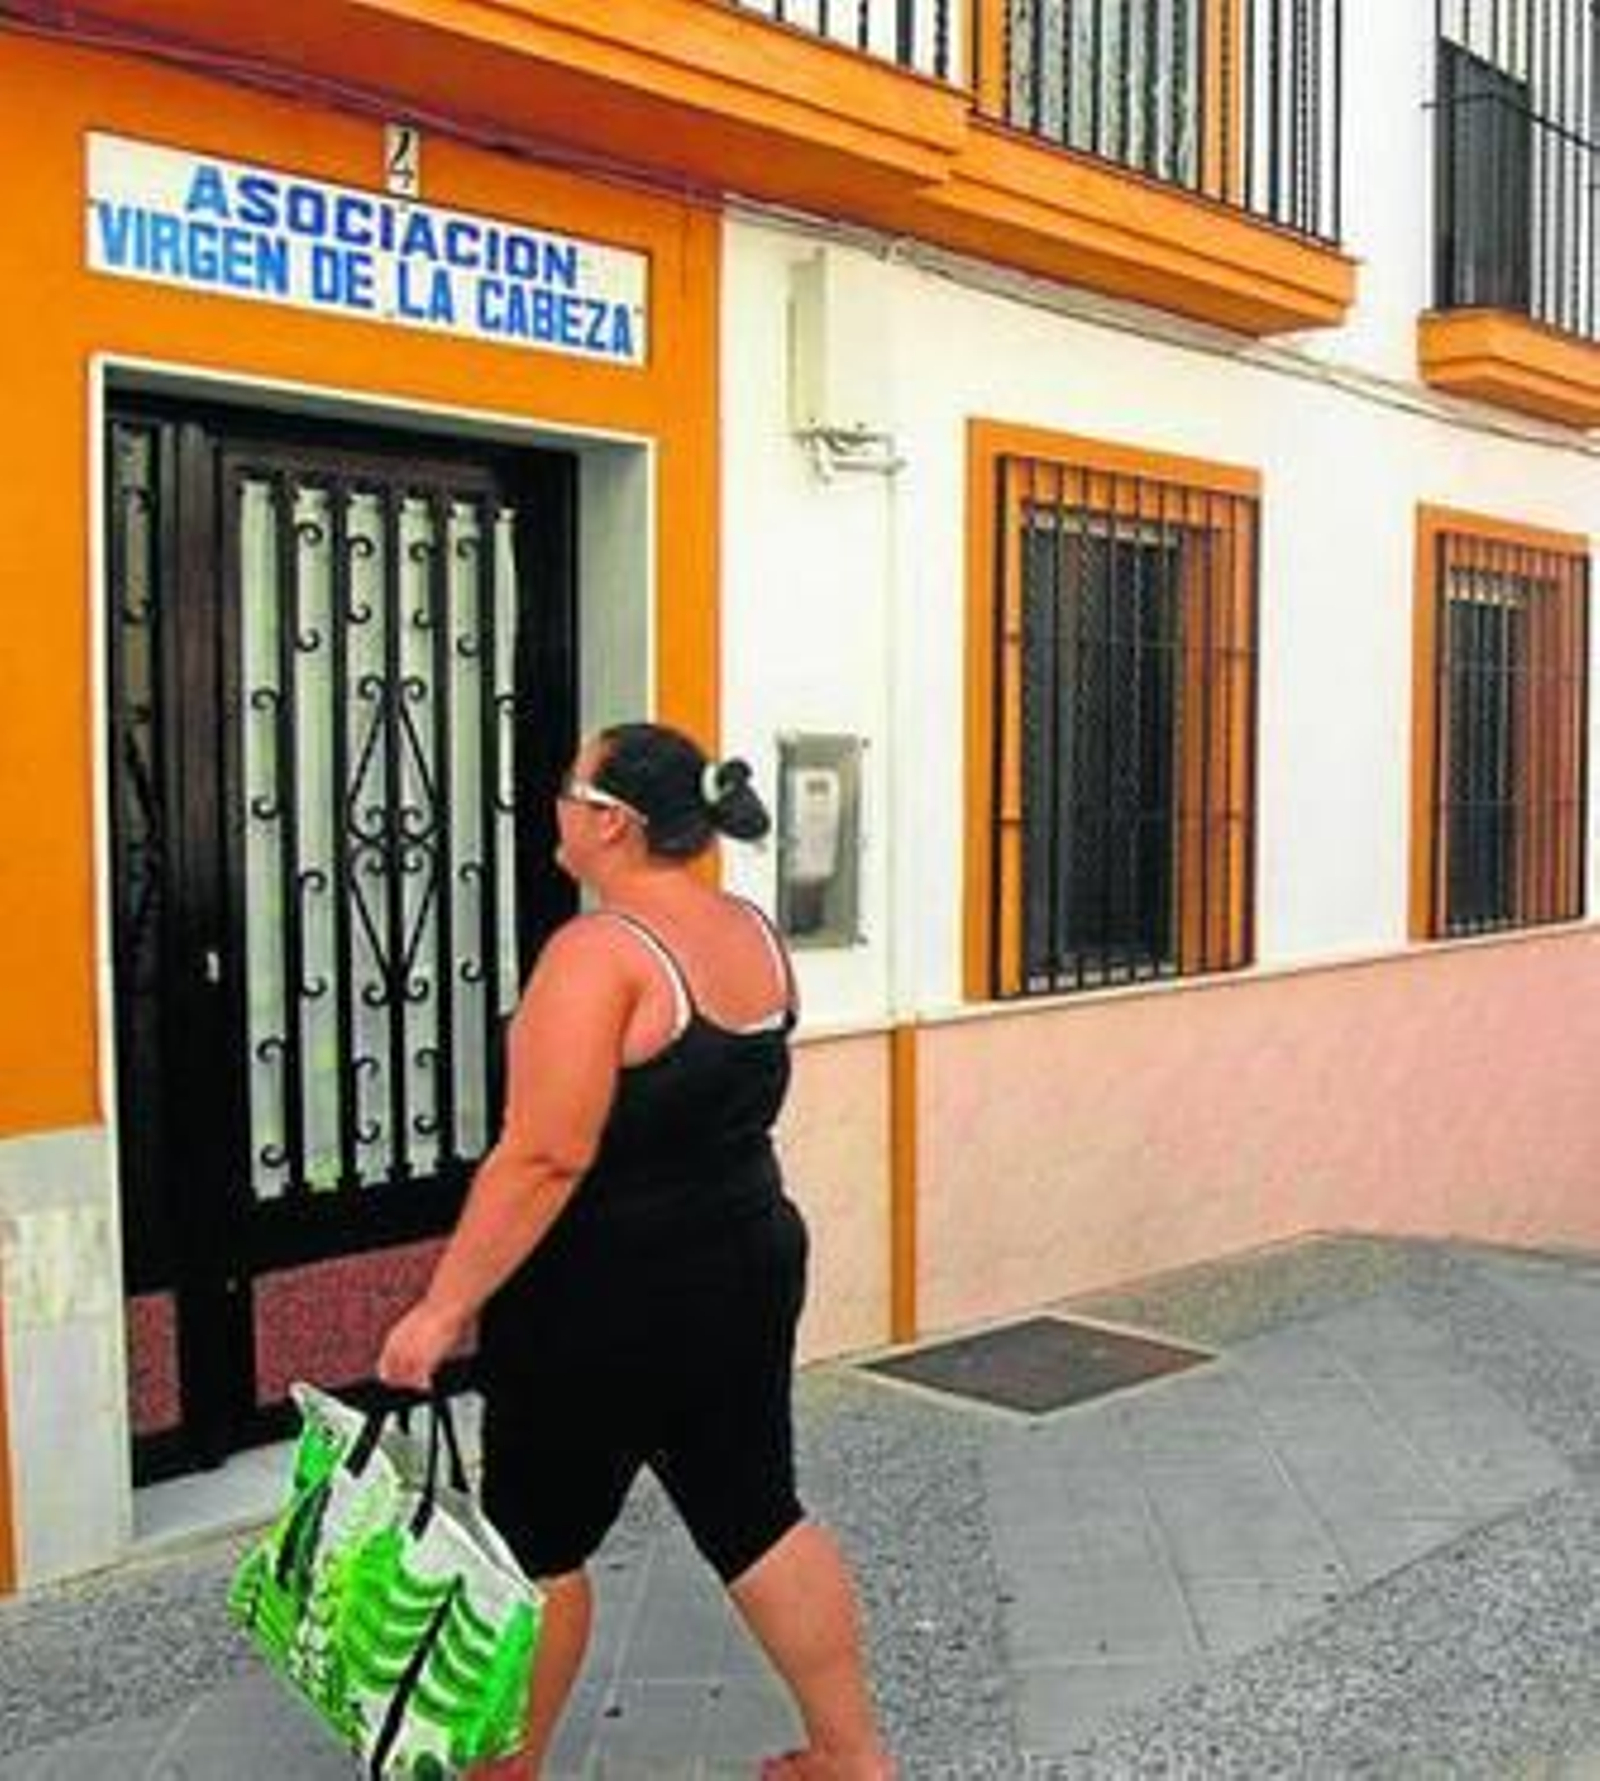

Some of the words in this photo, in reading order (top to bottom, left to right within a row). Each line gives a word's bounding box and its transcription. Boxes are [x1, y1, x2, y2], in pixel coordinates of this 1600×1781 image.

[186, 165, 577, 288] ASOCIACION
[312, 246, 375, 310] DE
[398, 261, 454, 323] LA
